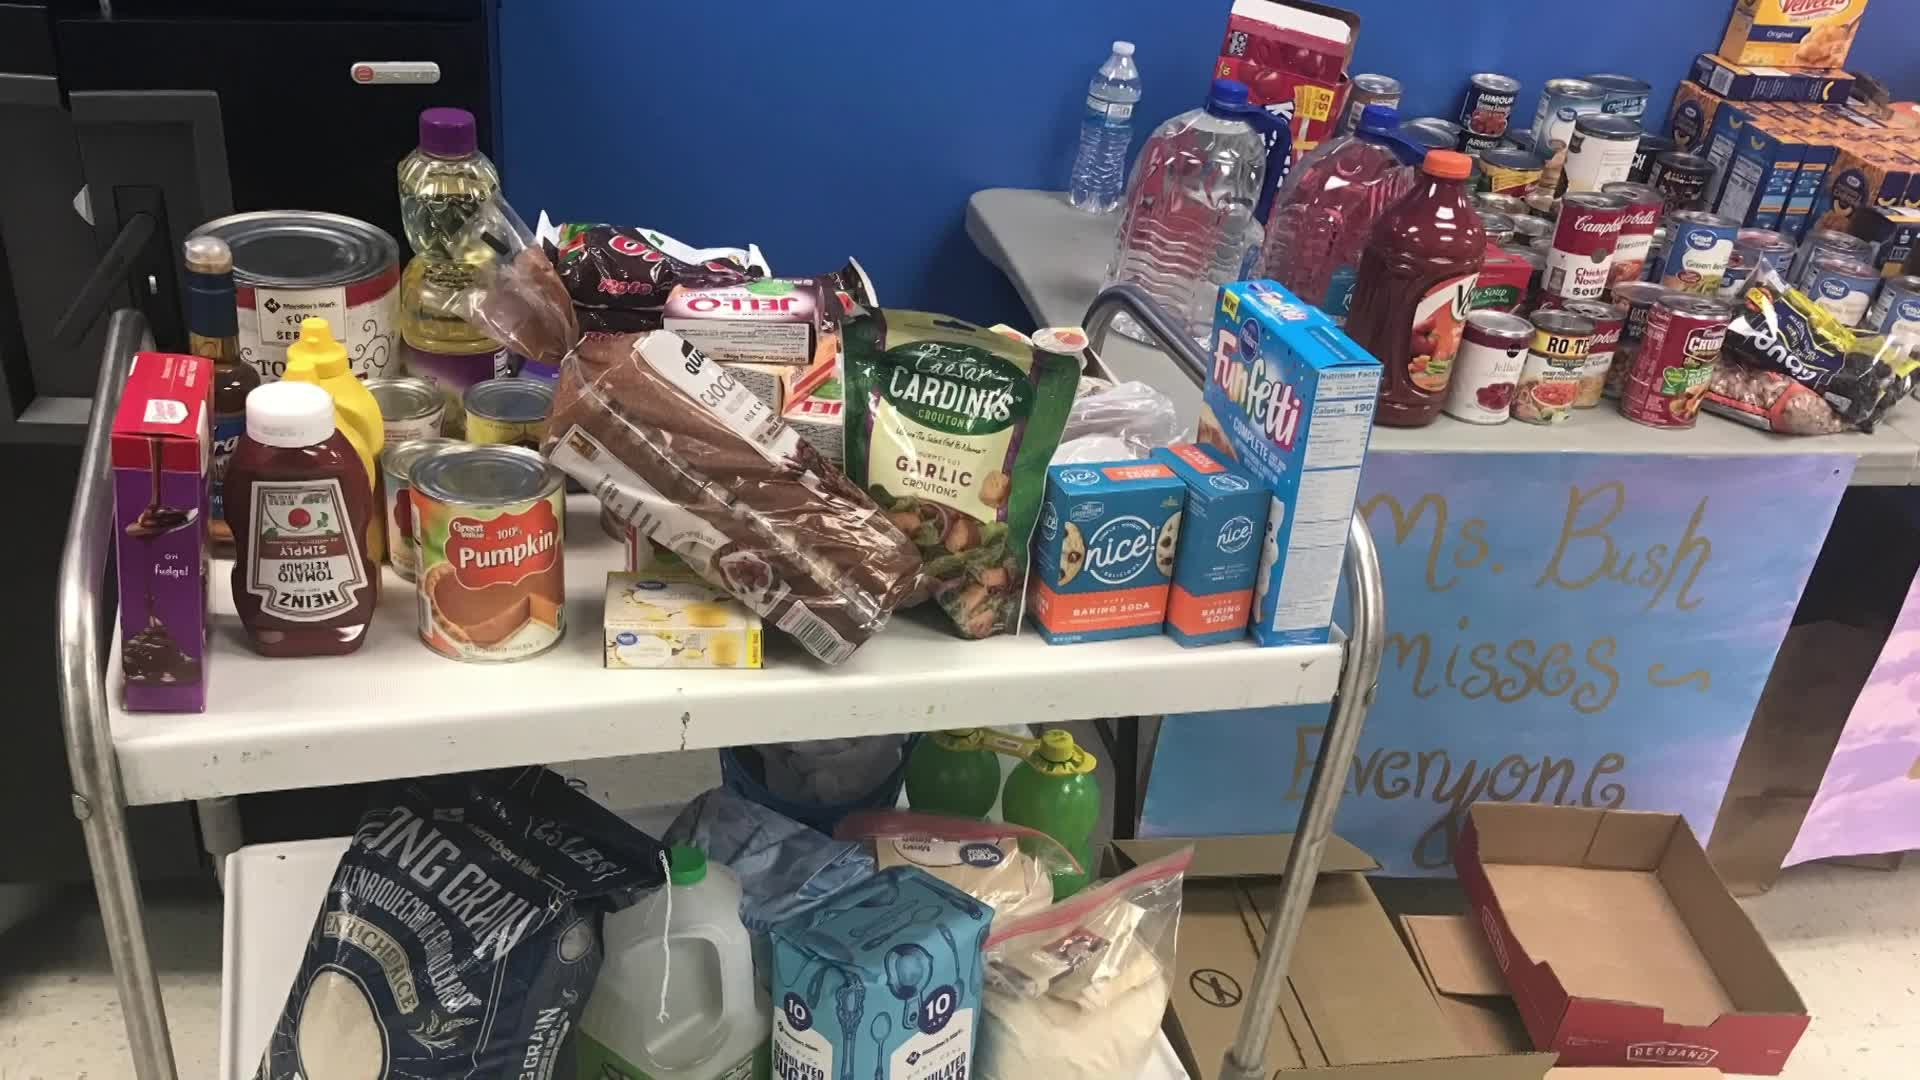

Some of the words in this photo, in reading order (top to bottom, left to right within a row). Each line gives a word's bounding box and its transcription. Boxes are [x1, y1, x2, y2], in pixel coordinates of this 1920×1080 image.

[1631, 153, 1647, 170] CH
[1690, 233, 1713, 242] Great
[687, 298, 799, 313] JELL-O
[1320, 371, 1356, 380] Nutrition
[1358, 371, 1380, 379] Facts
[1213, 329, 1301, 446] Funfetti
[1354, 403, 1373, 413] 190
[1233, 416, 1269, 462] COMPLETE
[895, 455, 973, 488] GARLIC
[902, 477, 959, 499] CROUTONS
[280, 544, 328, 556] SIMPLY
[459, 529, 554, 569] Pumpkin
[1084, 527, 1157, 572] nice!
[1536, 480, 1713, 613] Bush
[278, 561, 330, 573] KETCHUP
[278, 570, 334, 584] TOMATO
[278, 590, 339, 609] HEINZ
[1072, 605, 1118, 617] BAKING
[1120, 601, 1151, 612] SODA
[1201, 605, 1241, 617] BAKING
[1206, 614, 1235, 625] SODA
[437, 863, 541, 961] GRAIN
[787, 998, 807, 1022] 10
[926, 992, 951, 1021] 10
[523, 1006, 562, 1070] GRAIN
